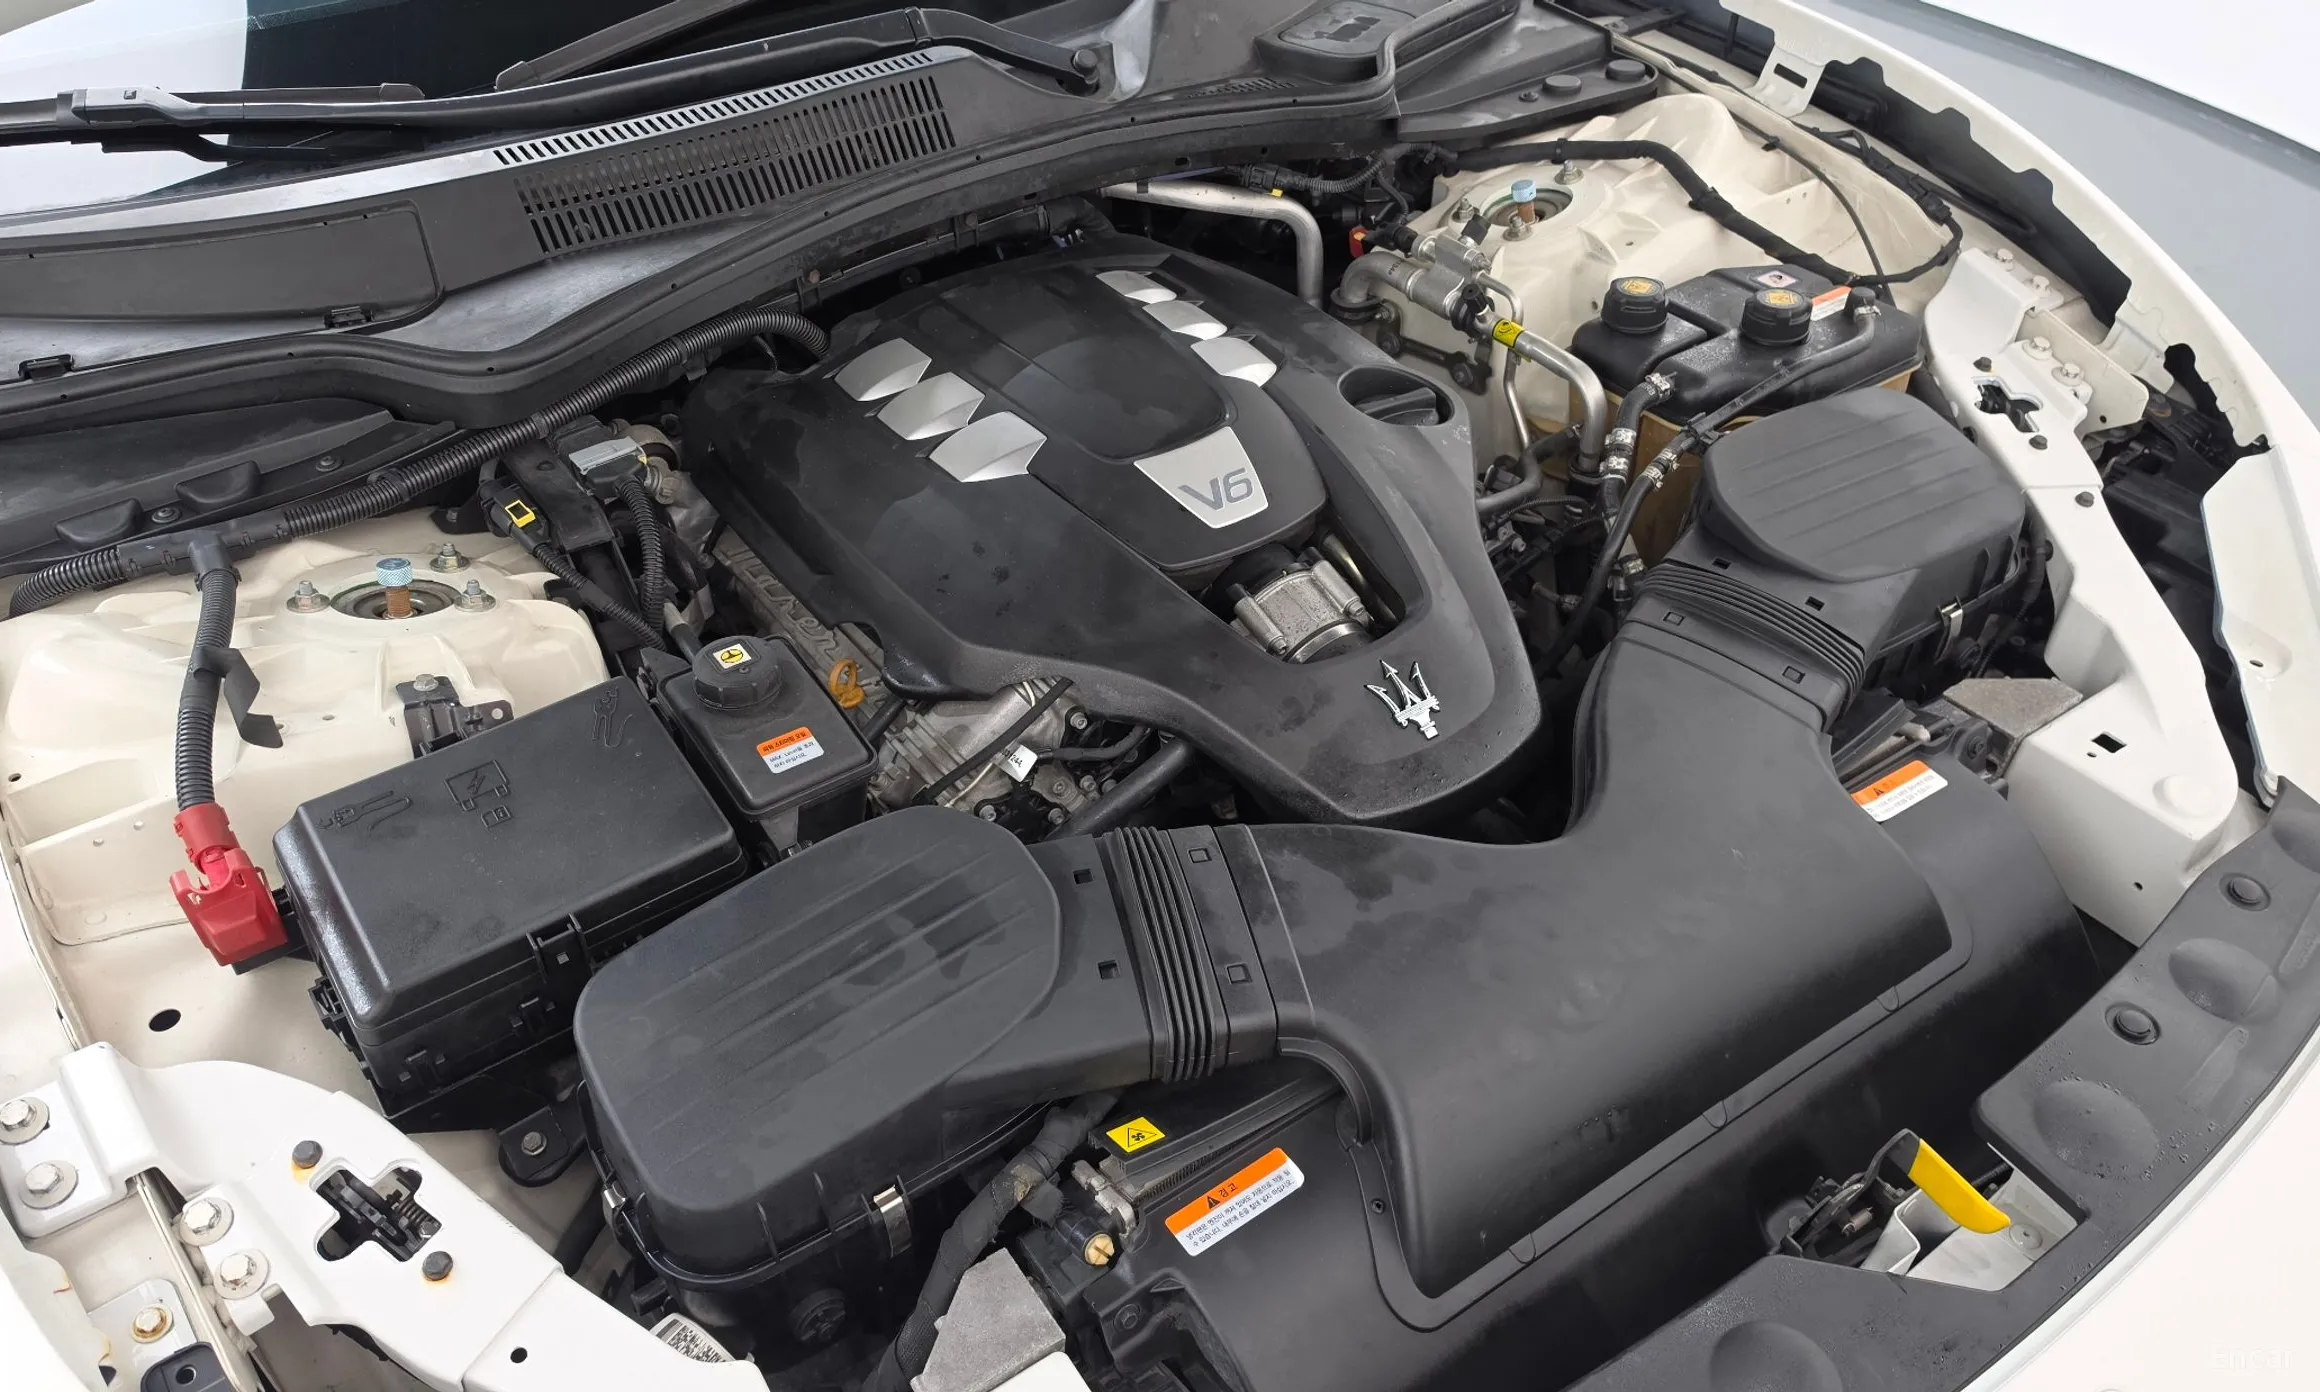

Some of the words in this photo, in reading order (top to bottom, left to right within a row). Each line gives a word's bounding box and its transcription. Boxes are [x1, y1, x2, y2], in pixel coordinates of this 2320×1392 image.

[1178, 467, 1253, 511] V6
[1186, 1223, 1208, 1240] 냉각팬은
[1207, 1212, 1225, 1226] 엔진이
[1235, 1196, 1251, 1208] 있어도
[1252, 1182, 1273, 1197] 자동으로
[1199, 1227, 1222, 1243] 있습니다.
[1222, 1214, 1239, 1228] 내부에
[1239, 1207, 1250, 1218] 손을
[1249, 1200, 1261, 1210] 절대
[1260, 1192, 1272, 1203] 넣지
[1272, 1179, 1295, 1195] 마십시오.
